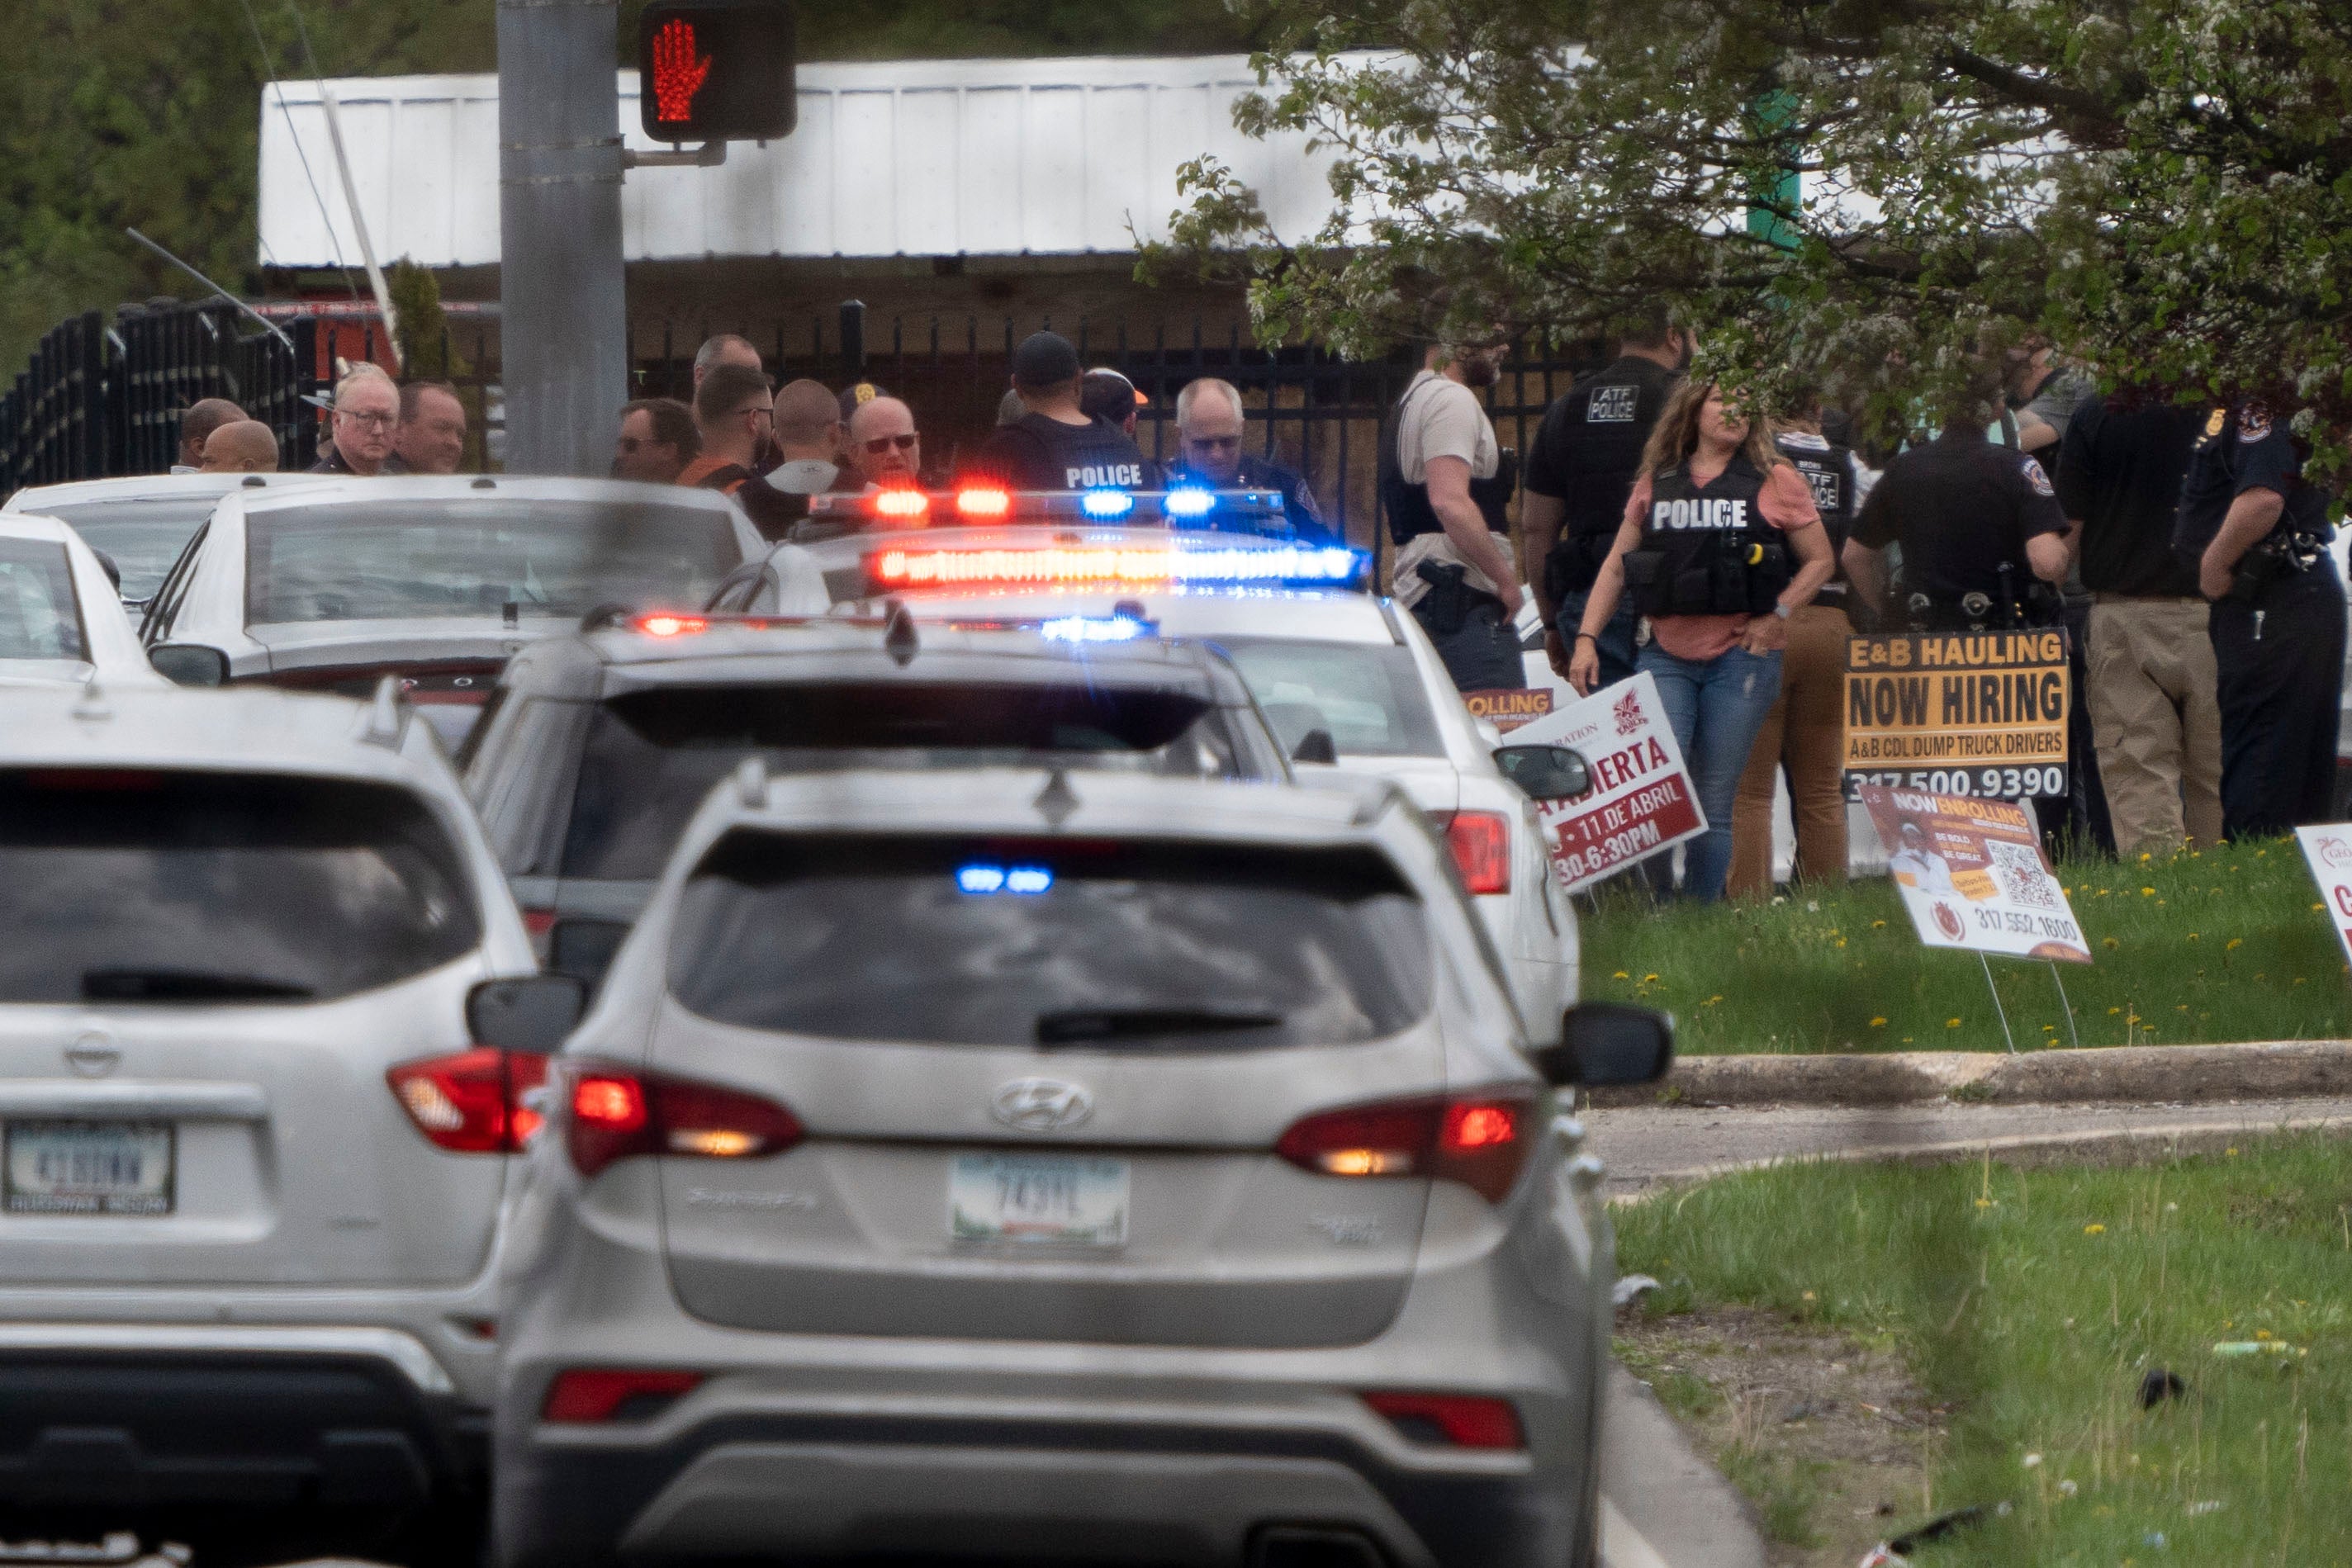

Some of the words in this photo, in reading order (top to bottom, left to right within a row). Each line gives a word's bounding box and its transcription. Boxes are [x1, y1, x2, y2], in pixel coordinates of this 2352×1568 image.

[1591, 401, 1634, 419] POLICE
[1599, 388, 1633, 401] ATF
[1066, 464, 1143, 488] POLICE
[1800, 472, 1832, 486] TF
[1653, 499, 1748, 530] POLICE
[1850, 639, 1912, 667] E&B
[1922, 633, 2062, 666] HAULING
[1850, 677, 1930, 727] NOW
[1942, 671, 2062, 726] HIRING
[1850, 739, 1880, 759] A&B
[1884, 737, 1909, 758] CDL
[1913, 736, 1954, 756] DUMP
[1957, 734, 2002, 755] TRUCK
[2006, 732, 2062, 753] DRIVERS
[1850, 766, 2063, 800] 317500.9390
[1579, 815, 1601, 841] 11
[1604, 803, 1628, 830] DE
[1630, 781, 1682, 819] ABRIL
[1891, 792, 1938, 814] NOW
[1938, 798, 2028, 827] ENROLLING
